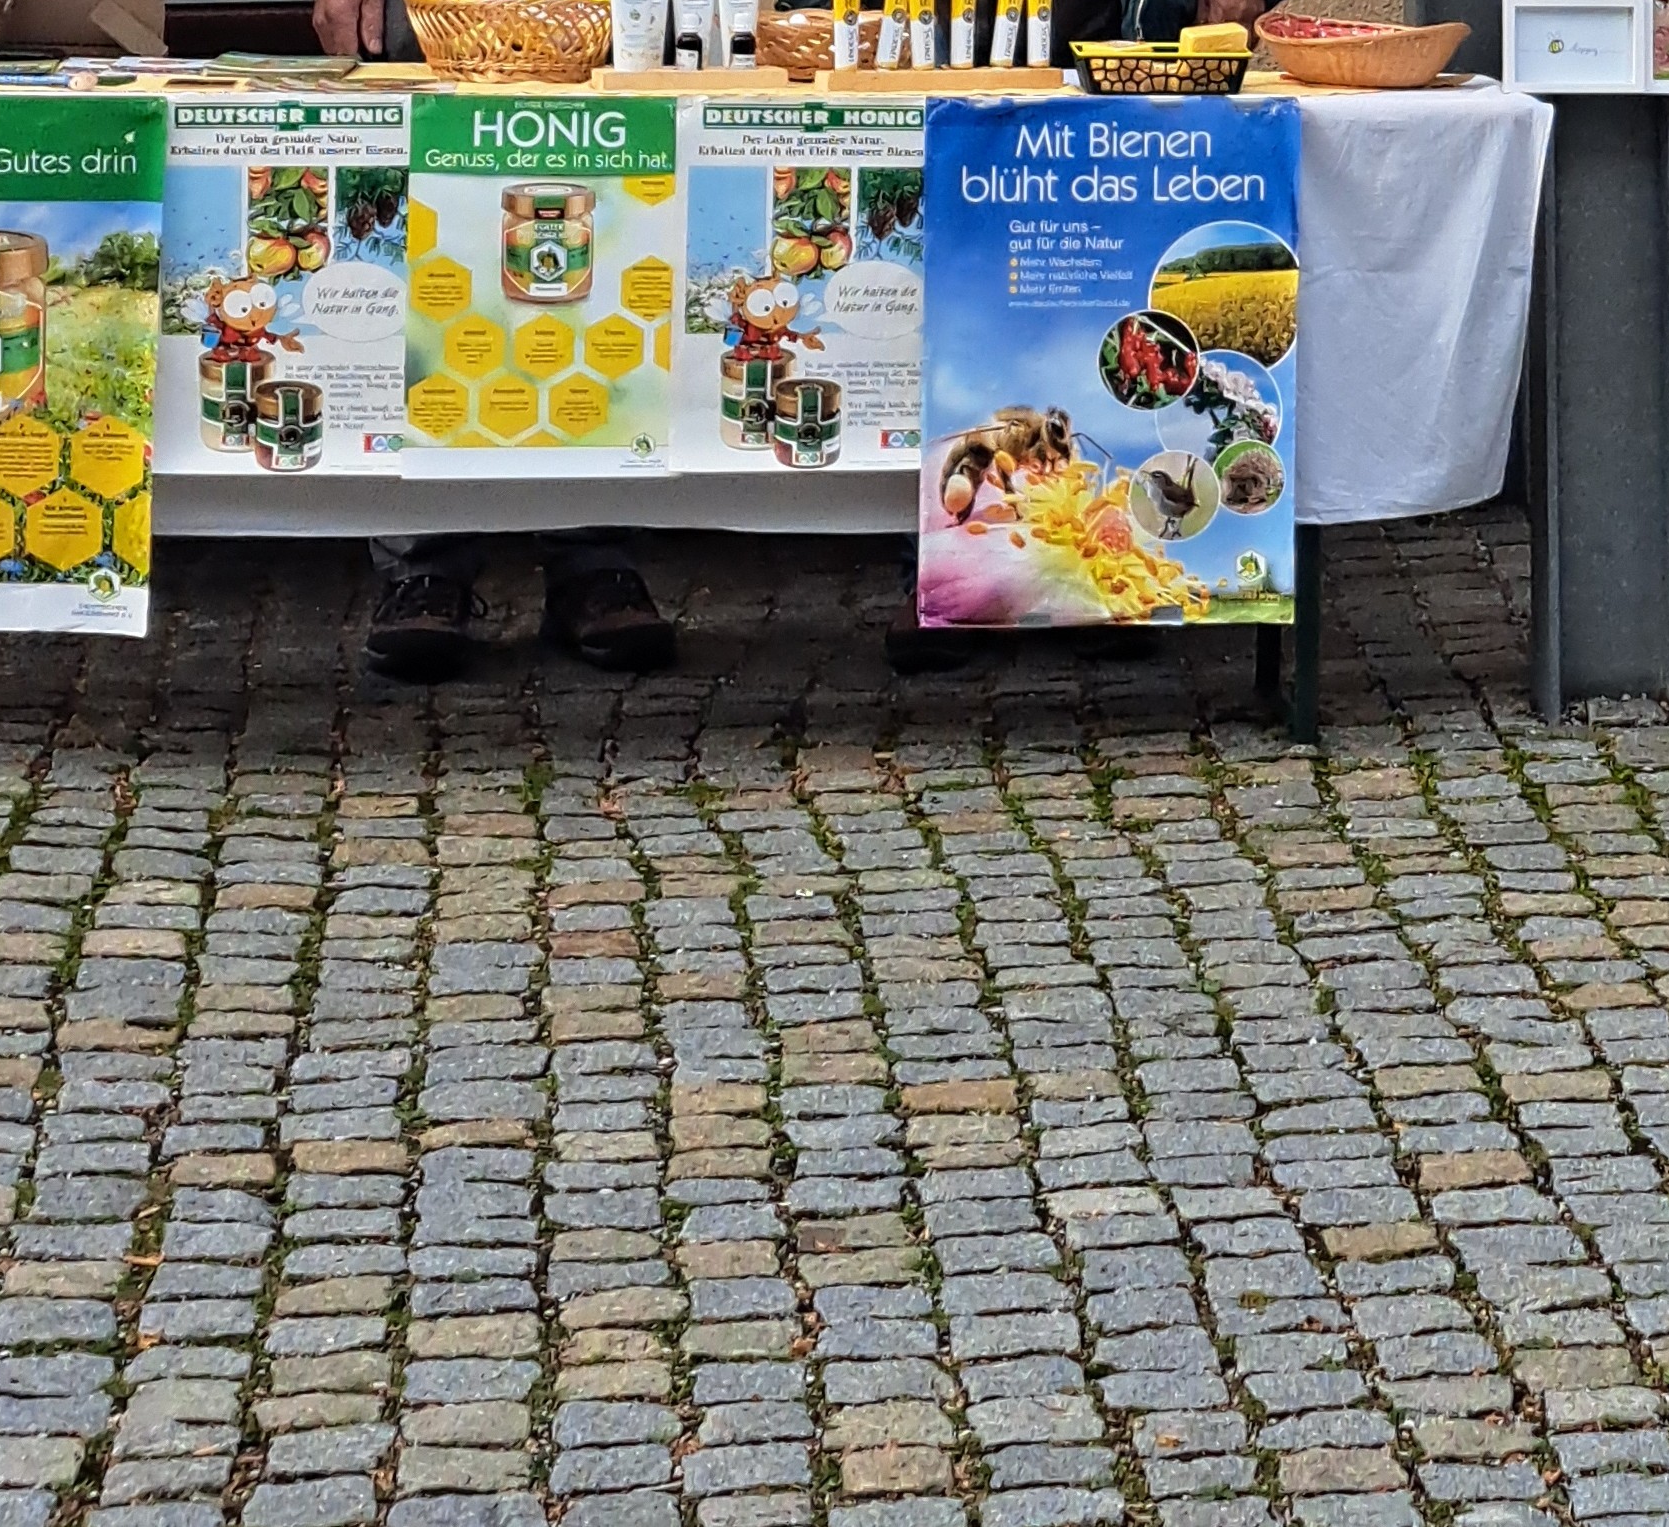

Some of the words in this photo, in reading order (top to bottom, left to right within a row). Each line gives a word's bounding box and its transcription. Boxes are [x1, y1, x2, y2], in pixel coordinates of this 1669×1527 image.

[178, 109, 305, 123] DEUTSCHER
[321, 108, 400, 122] HONIG
[706, 110, 829, 124] DEUTSCHER
[844, 111, 921, 125] HONIG
[473, 111, 626, 148] HONIG
[1015, 123, 1075, 158] Mit
[1089, 123, 1212, 158] Bienen
[82, 148, 137, 173] drin
[425, 149, 500, 171] Genuss,
[507, 150, 540, 168] der
[546, 153, 566, 167] es
[573, 150, 589, 167] in
[595, 150, 632, 167] sich
[639, 151, 672, 167] hat.
[961, 166, 1059, 203] blüht
[1072, 167, 1137, 202] das
[1154, 167, 1265, 202] Leben
[1009, 220, 1036, 232] Gut
[1040, 220, 1059, 232] für
[1063, 222, 1088, 232] uns
[1009, 238, 1032, 252] gut
[1036, 237, 1056, 250] für
[1059, 237, 1081, 249] die
[1085, 237, 1124, 250] Natur
